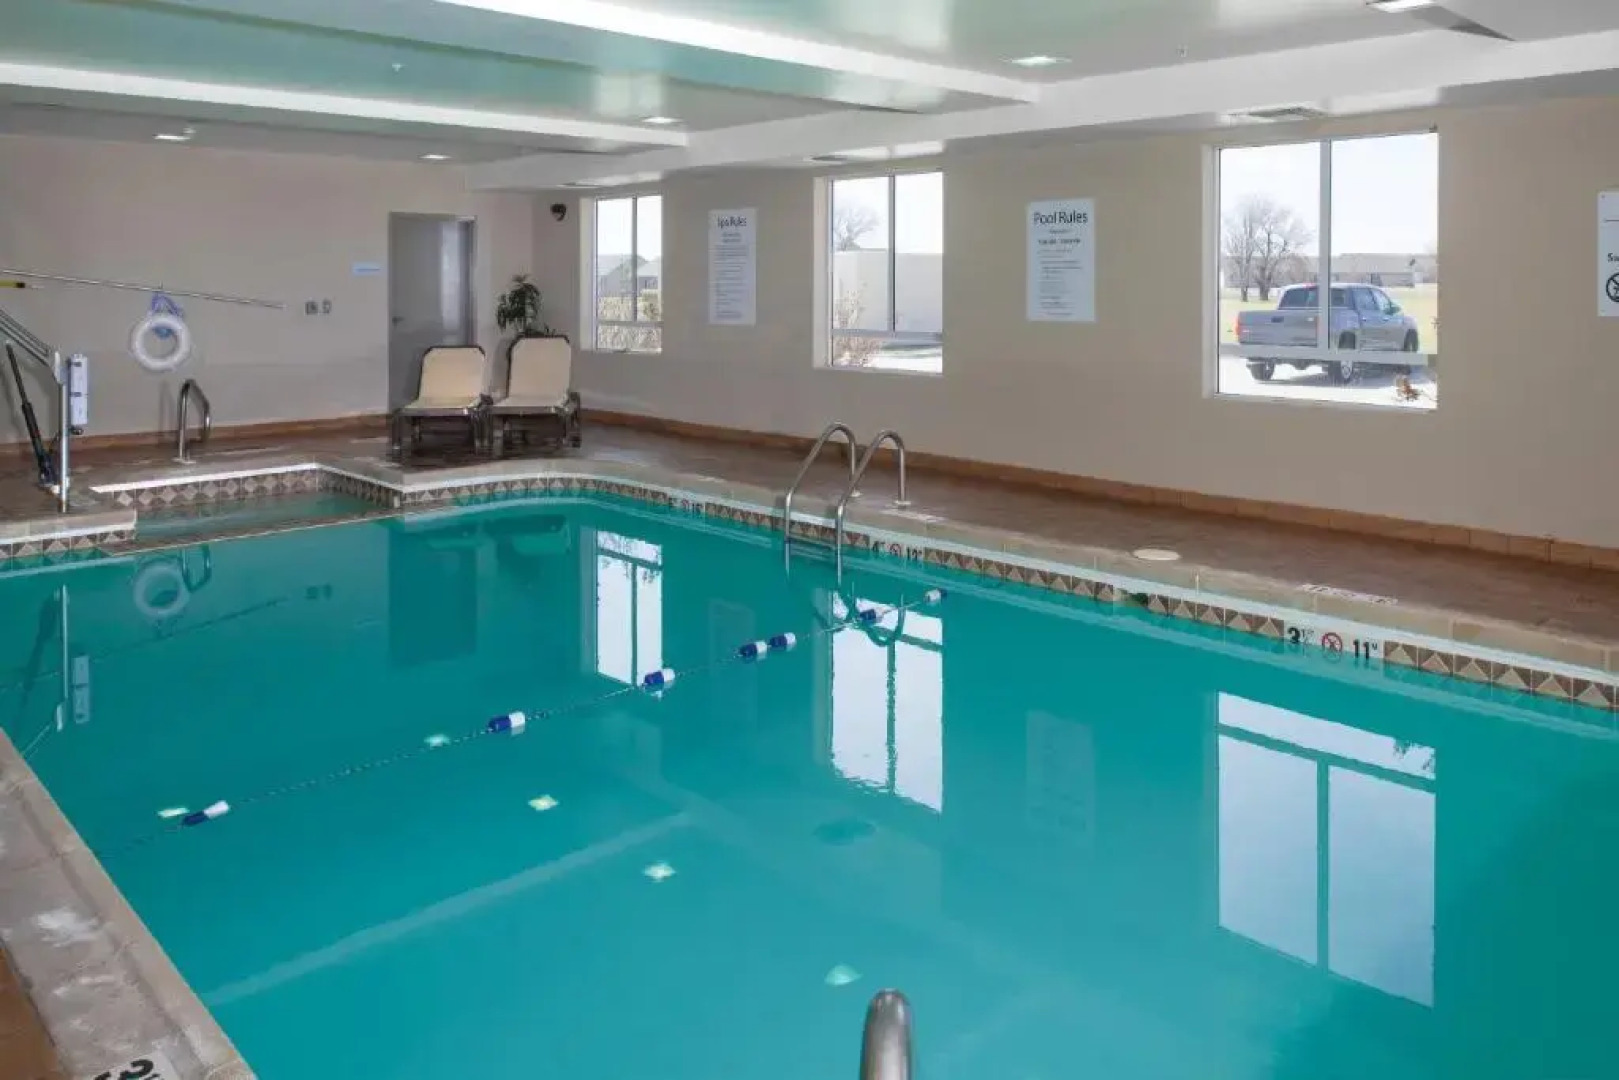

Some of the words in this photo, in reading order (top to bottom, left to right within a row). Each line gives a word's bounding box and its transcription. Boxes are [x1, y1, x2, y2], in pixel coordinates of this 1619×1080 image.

[730, 216, 747, 227] Rules
[1033, 212, 1057, 224] Pool
[1058, 210, 1088, 224] Rules
